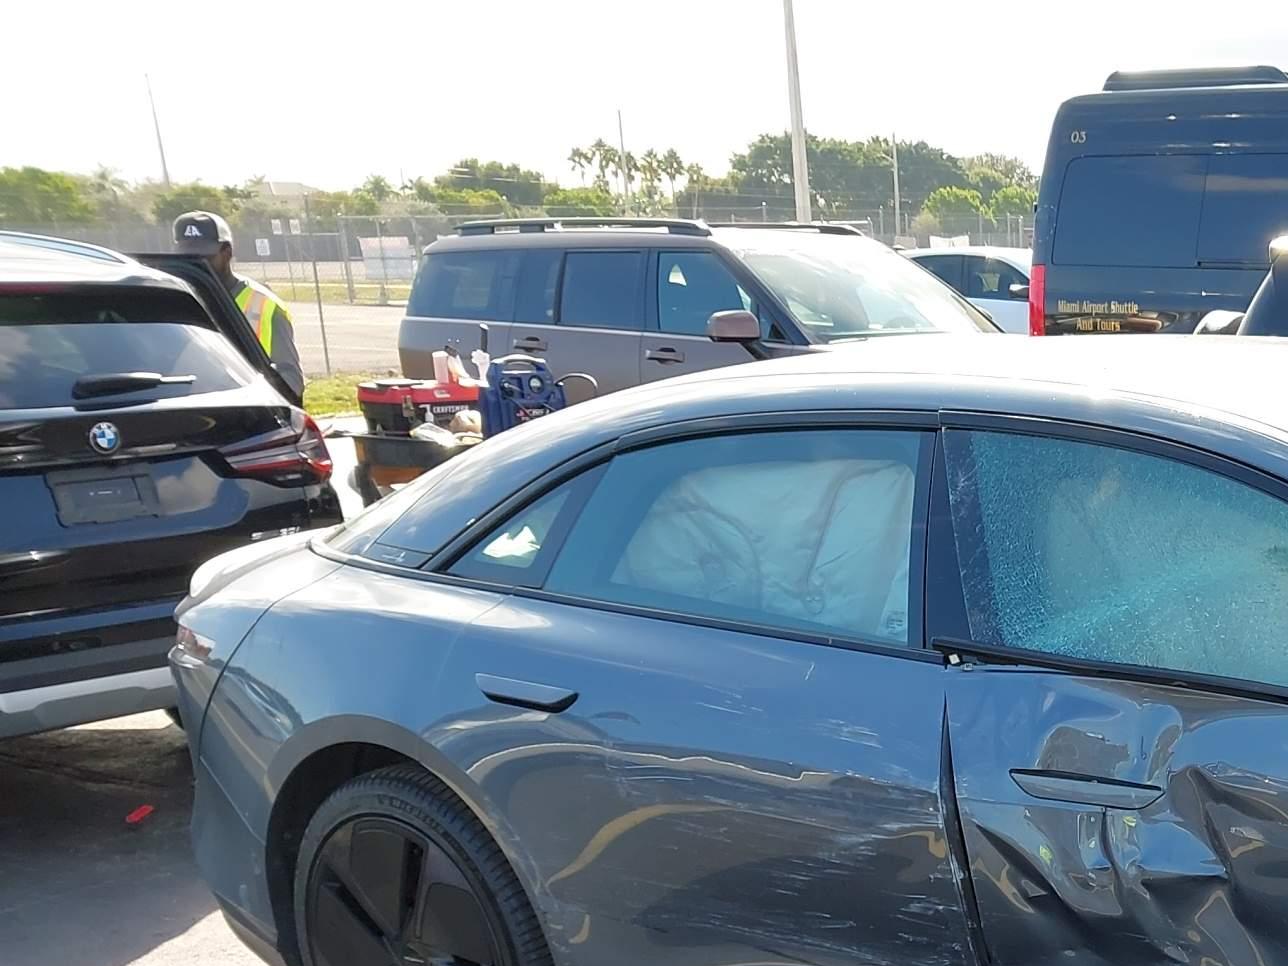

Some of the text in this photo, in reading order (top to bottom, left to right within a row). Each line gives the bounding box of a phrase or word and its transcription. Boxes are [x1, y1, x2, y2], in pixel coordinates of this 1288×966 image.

[1071, 131, 1086, 143] 03
[1058, 299, 1139, 316] Miami Airport Shuttle
[1076, 317, 1121, 331] And Tours
